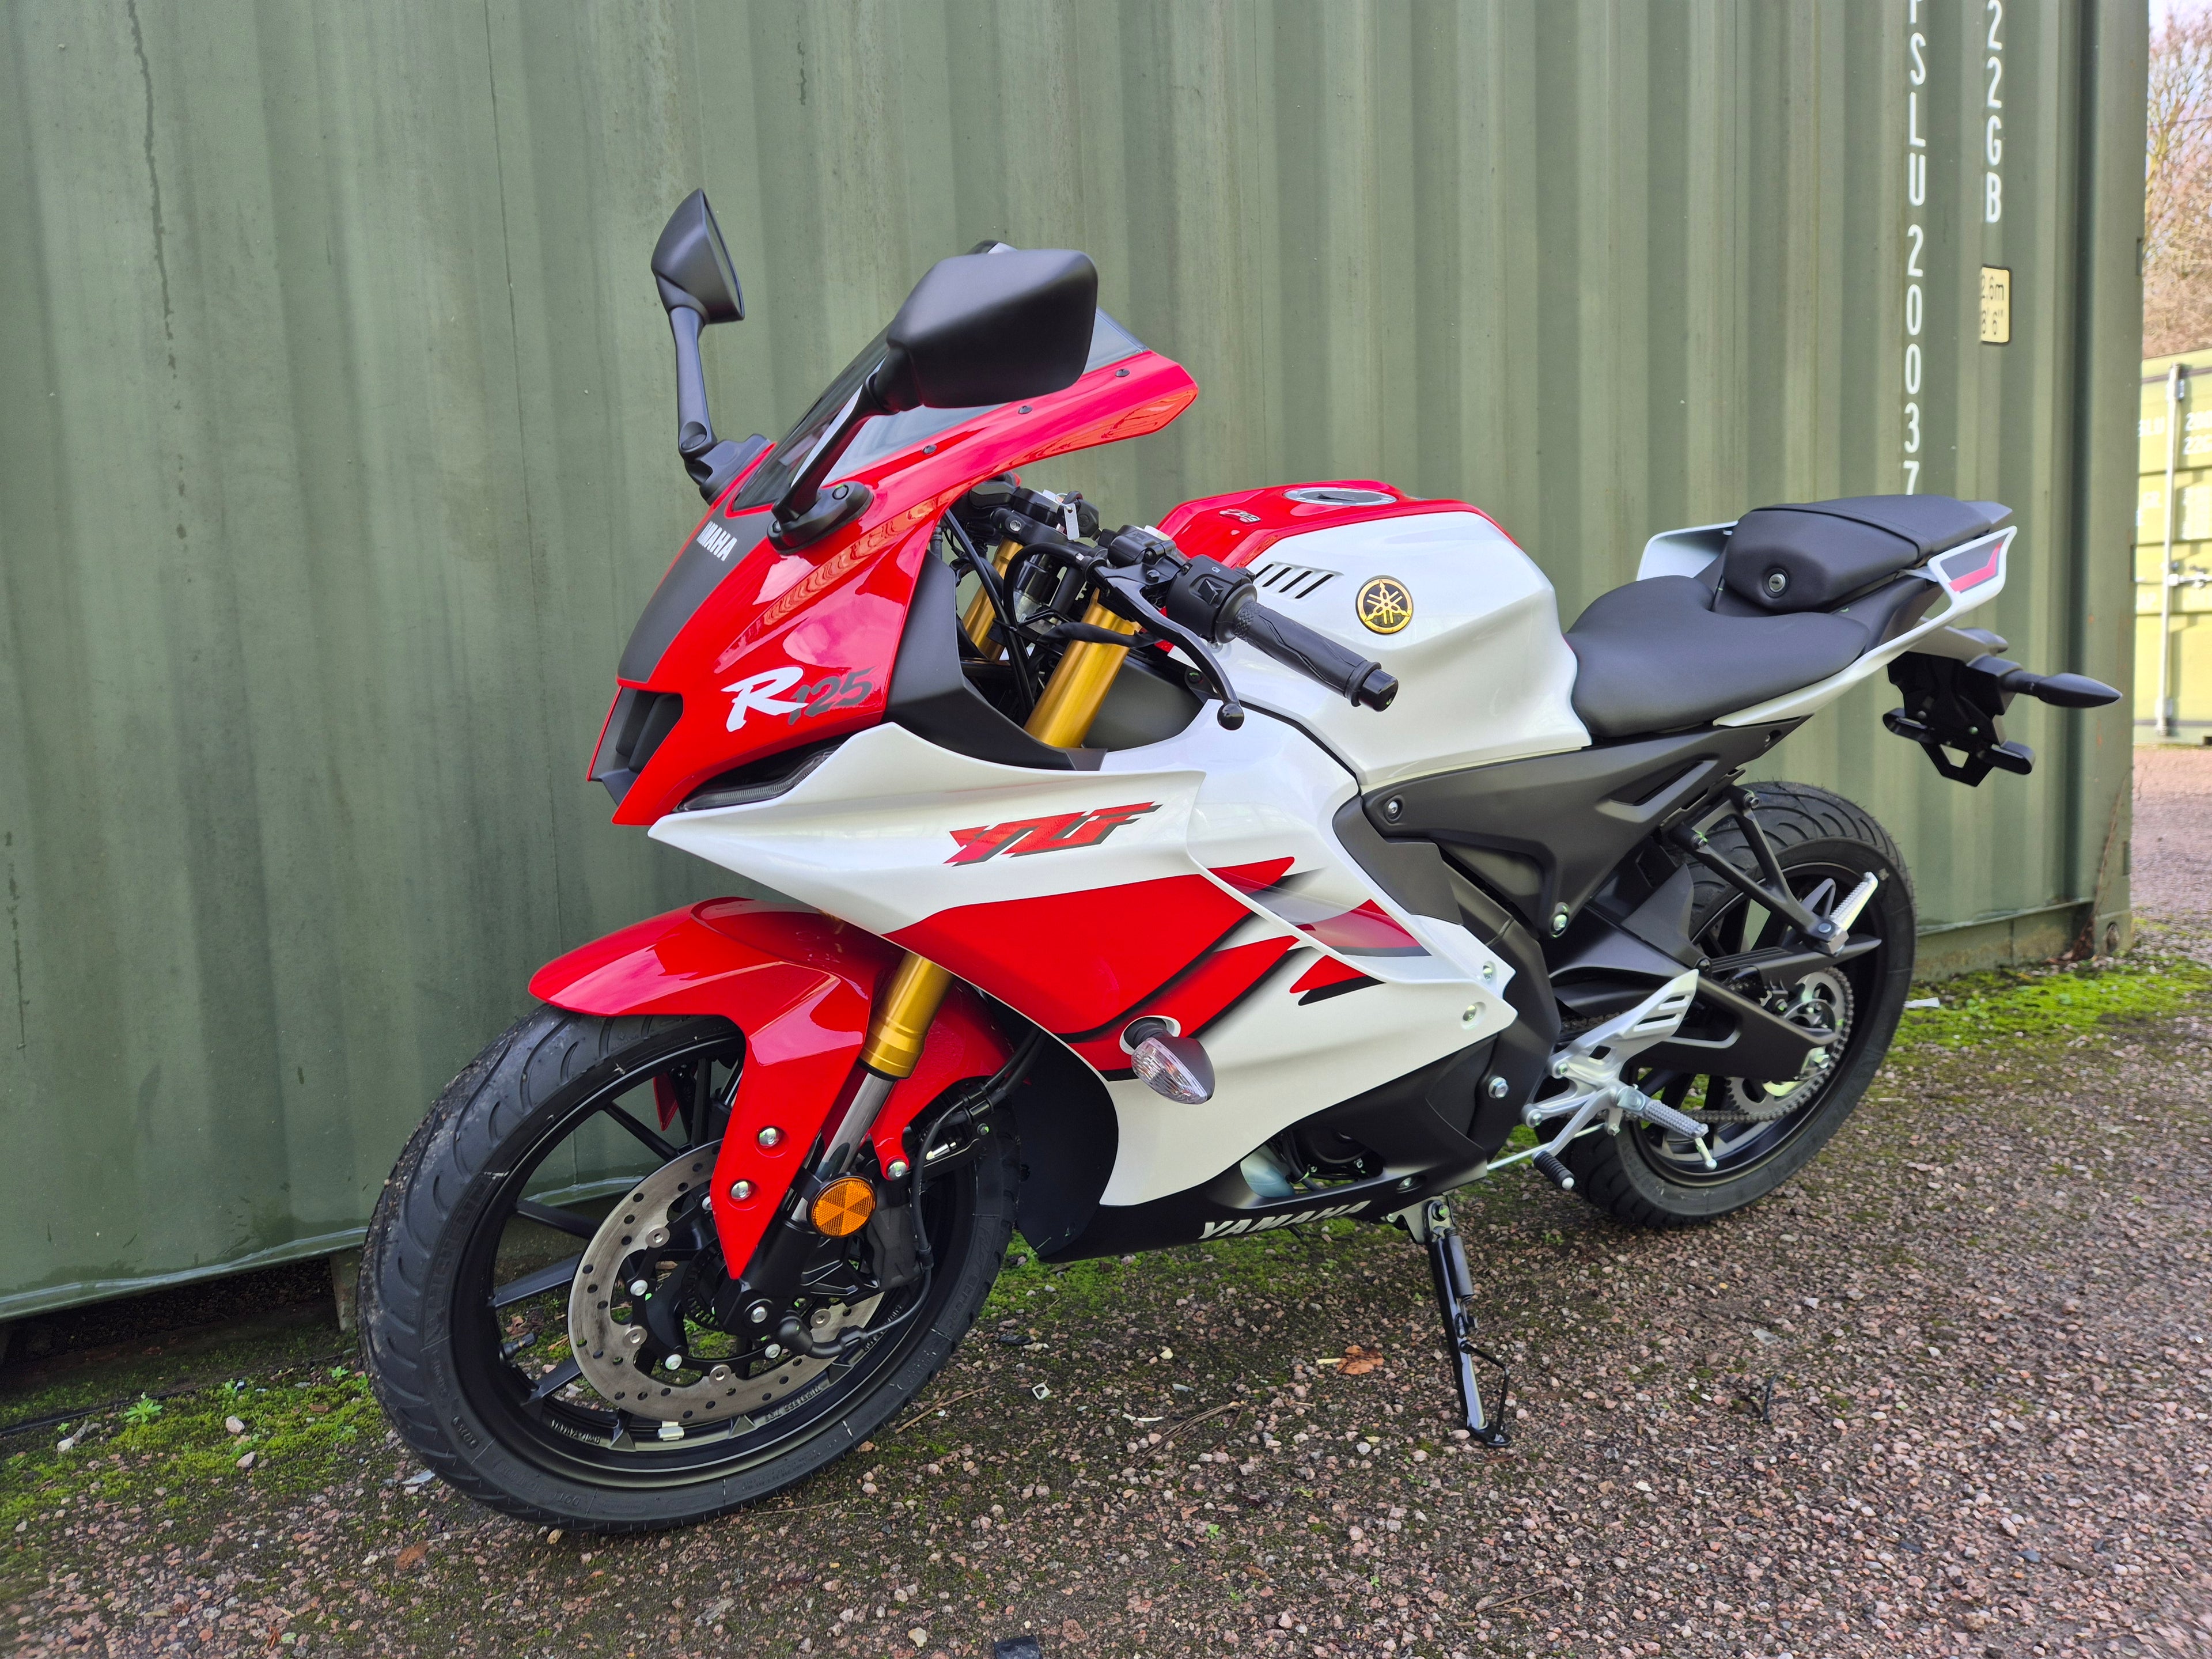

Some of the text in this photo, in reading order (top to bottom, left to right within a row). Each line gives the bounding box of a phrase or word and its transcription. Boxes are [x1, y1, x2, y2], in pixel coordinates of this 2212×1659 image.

[1985, 0, 2002, 224] 22GB
[696, 520, 737, 562] YAMAHA
[721, 666, 876, 732] R125
[942, 801, 1163, 867] YZF
[1198, 1200, 1372, 1240] YAMAHA
